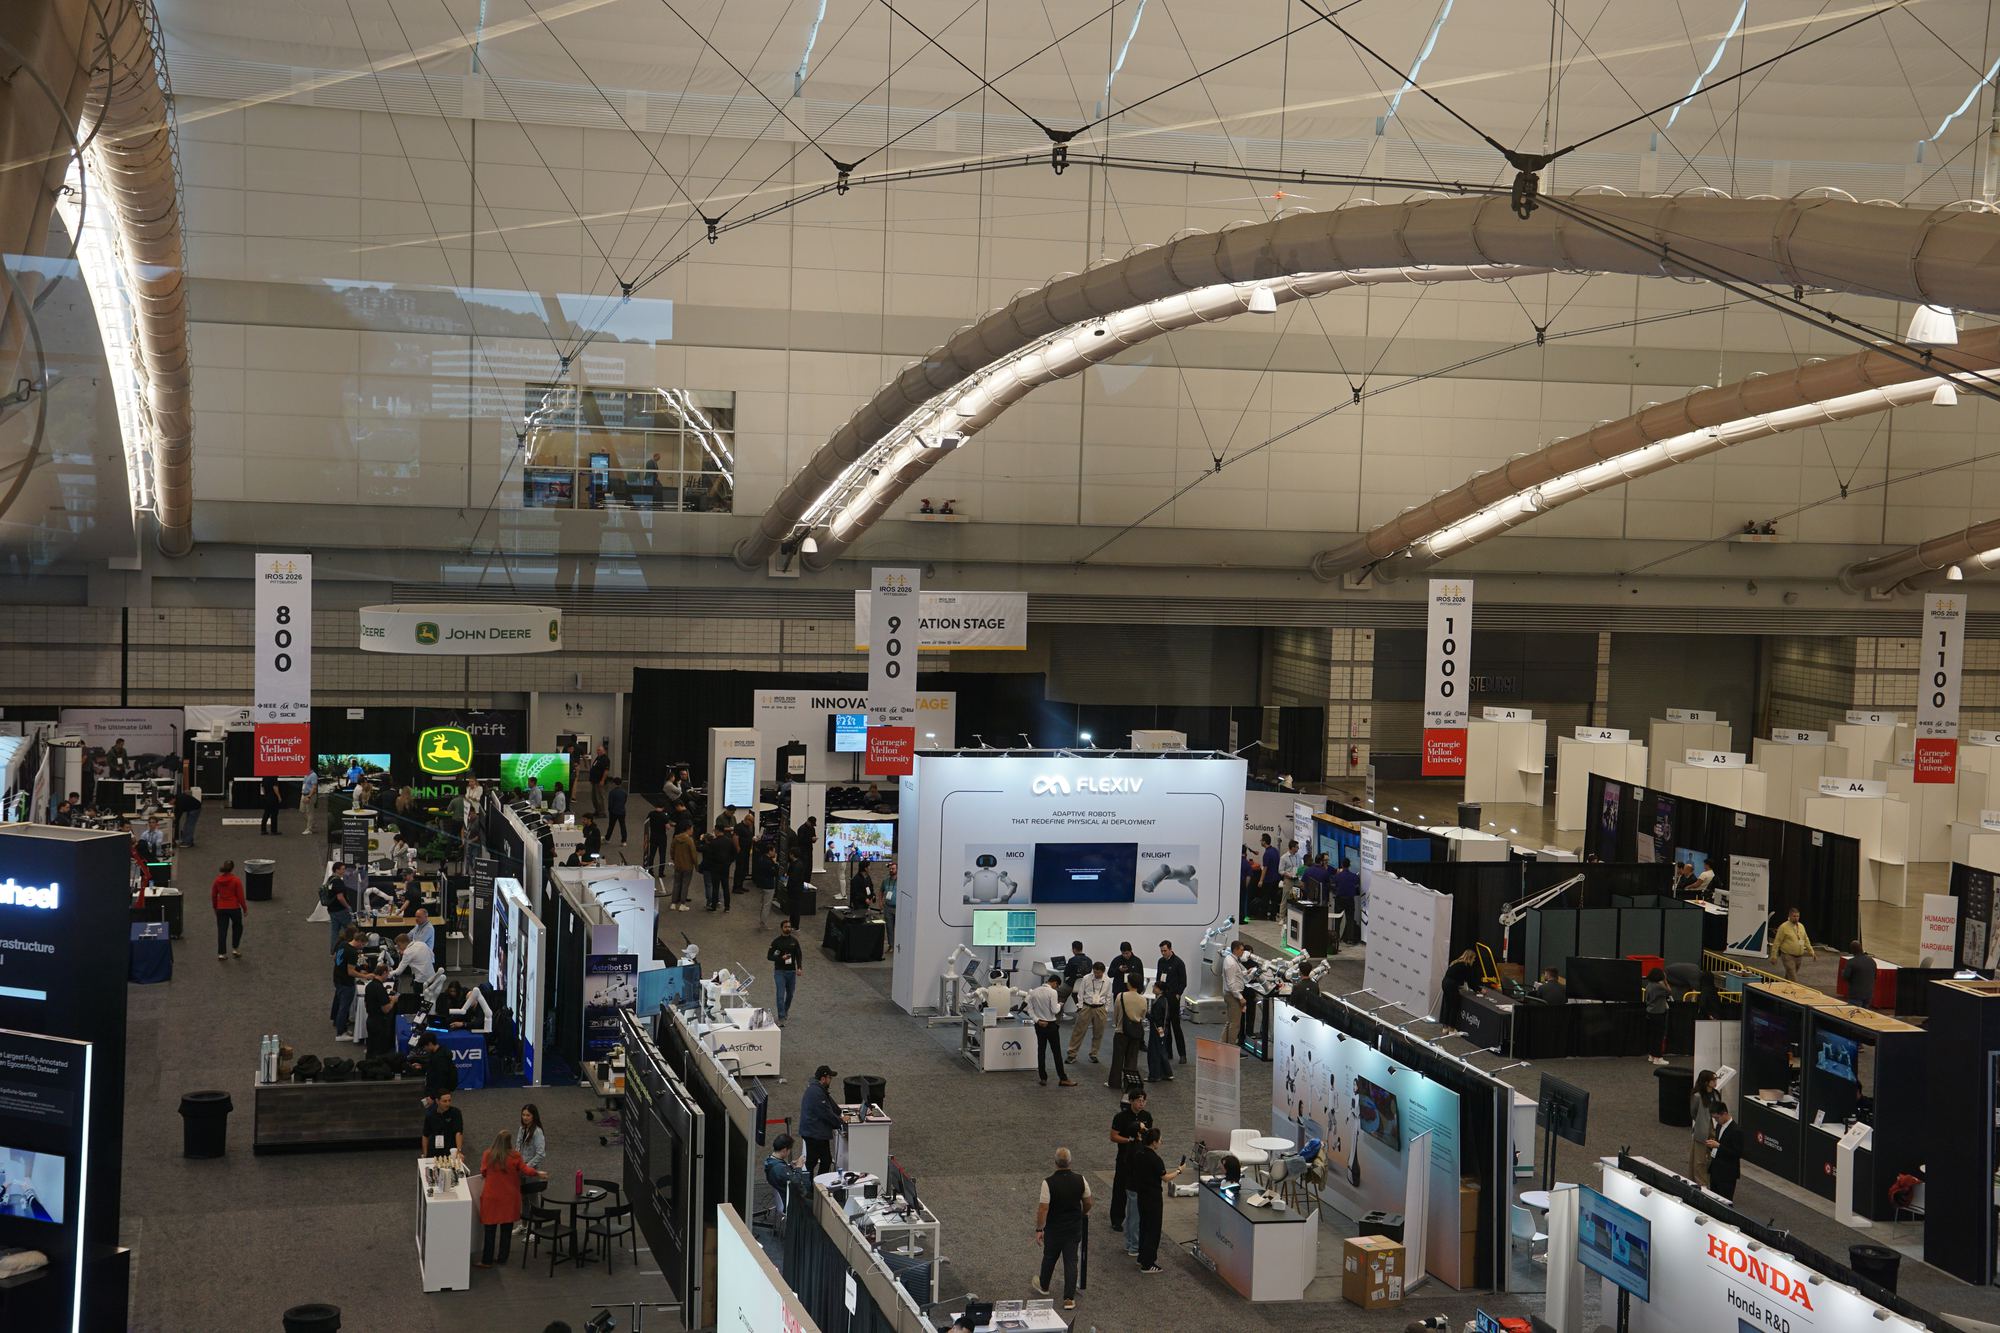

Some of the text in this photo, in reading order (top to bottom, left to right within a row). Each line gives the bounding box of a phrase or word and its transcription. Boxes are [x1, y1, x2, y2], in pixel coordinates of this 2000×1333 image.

[918, 618, 1005, 629] ATION STAGE
[275, 606, 292, 672] 800
[445, 628, 531, 640] JOHN DEERE
[885, 616, 902, 678] 900
[1441, 618, 1456, 698] 1000
[1932, 631, 1946, 708] 1100
[811, 698, 868, 709] INNOVA
[466, 723, 506, 735] drift
[260, 736, 302, 746] Carnegie
[871, 737, 907, 748] Carnegie
[1428, 740, 1460, 749] Carnegie
[260, 745, 292, 753] Mellon
[1919, 749, 1950, 757] Carnegie
[260, 754, 305, 763] University
[871, 755, 910, 764] University
[1428, 756, 1462, 765] University
[1918, 764, 1952, 773] University
[1076, 776, 1144, 793] FLEXIV
[1849, 784, 1864, 792] A4
[1246, 823, 1274, 831] Solutions
[1925, 915, 1955, 924] HUMANOID
[1922, 942, 1953, 952] HARDWARE
[3, 1051, 24, 1060] Largest
[25, 1055, 68, 1068] Fully-Annotated
[7, 1060, 36, 1070] Egocentric
[37, 1065, 58, 1074] Dataset
[1707, 1233, 1814, 1312] HONDA
[1728, 1288, 1790, 1333] Honda R&D
